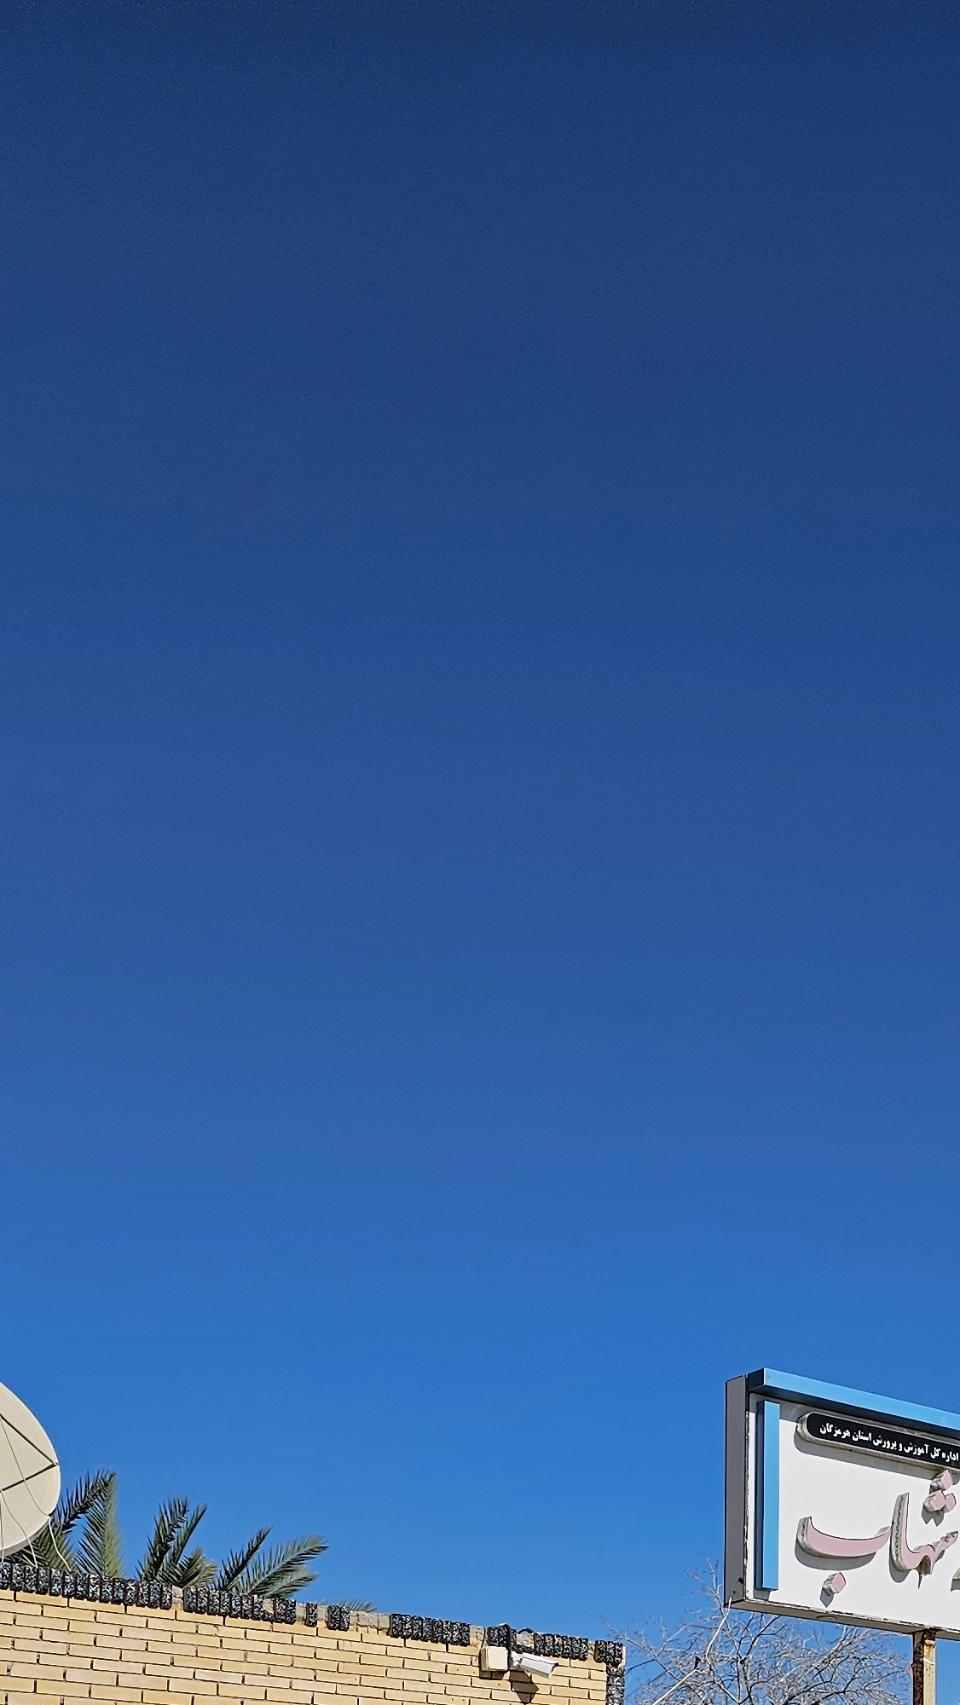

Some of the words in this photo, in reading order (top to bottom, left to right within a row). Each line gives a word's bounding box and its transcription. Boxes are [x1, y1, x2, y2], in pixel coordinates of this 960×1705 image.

[819, 1422, 851, 1438] هرمزگان
[852, 1429, 872, 1442] استان
[872, 1433, 897, 1450] پرورش
[904, 1443, 929, 1456] آموزش
[930, 1446, 940, 1458] کل
[941, 1449, 959, 1462] اداره
[796, 1469, 959, 1594] شهاب
